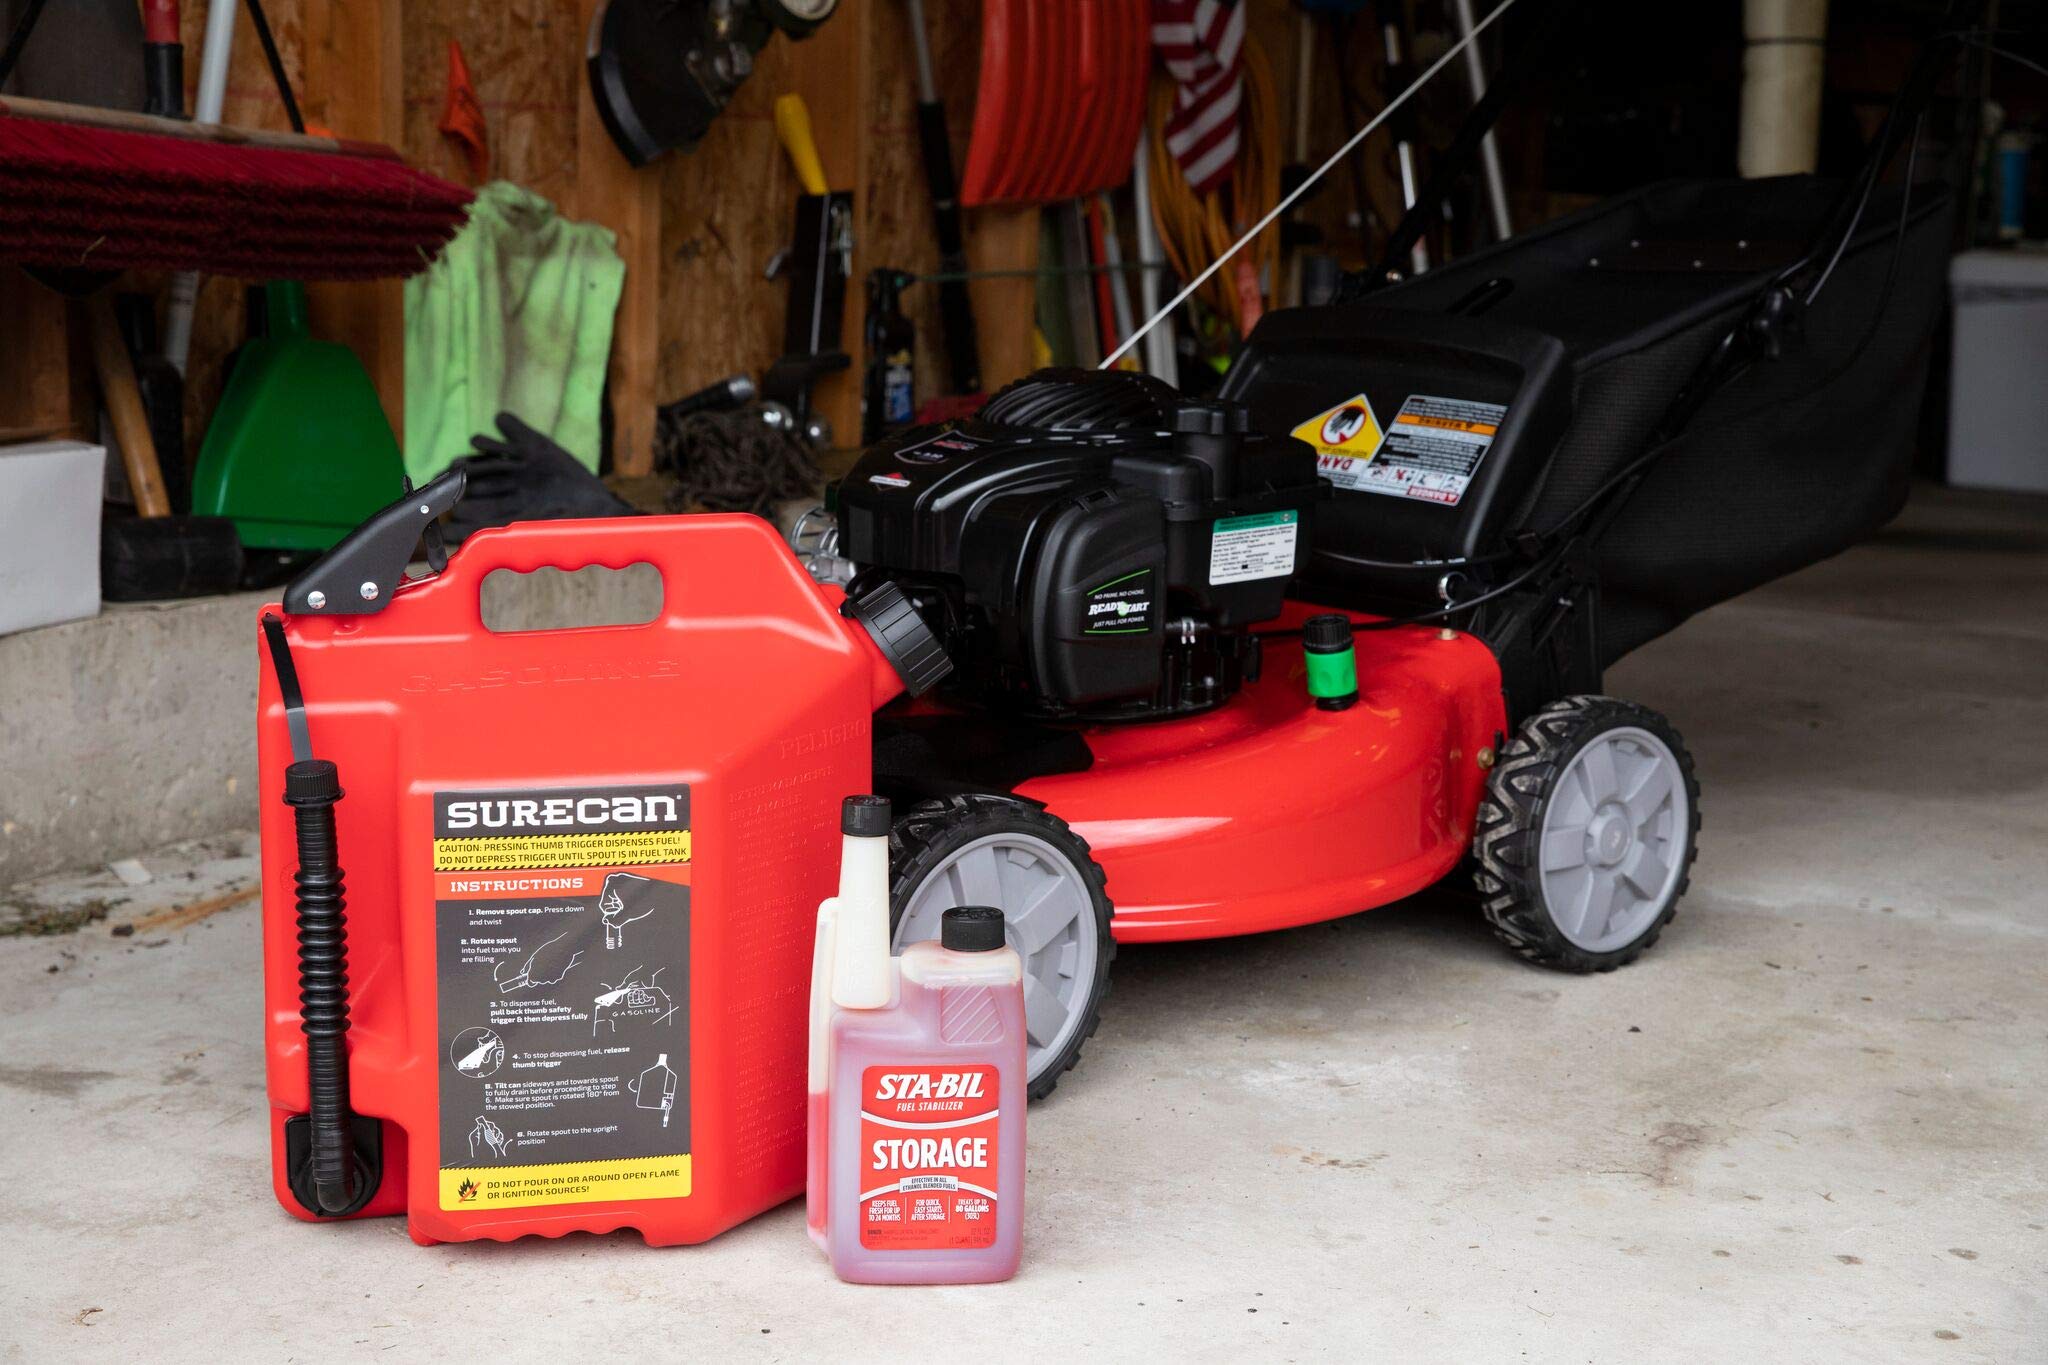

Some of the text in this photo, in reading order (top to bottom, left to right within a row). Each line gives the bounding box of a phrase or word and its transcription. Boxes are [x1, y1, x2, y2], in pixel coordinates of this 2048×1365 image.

[440, 837, 681, 853] CAUTION: PRESSING THUMB TRIGGER DISPENSES FUEL!
[440, 856, 452, 864] DO
[455, 856, 474, 864] NOT
[476, 855, 516, 863] DEPRESS
[518, 853, 557, 862] TRIGGER
[559, 852, 585, 861] UNTIL
[587, 851, 617, 860] SPOUT
[629, 850, 638, 858] IN
[640, 849, 661, 857] FUEL
[663, 848, 687, 856] TANK
[450, 878, 583, 892] INSTRUCTIONS
[475, 956, 495, 964] filling
[509, 1000, 540, 1008] dispense
[491, 1009, 505, 1017] pull
[612, 1008, 661, 1017] GASOLINE
[491, 1017, 515, 1025] trigger
[542, 1014, 570, 1022] depress
[550, 1050, 586, 1058] dispensing
[604, 1046, 630, 1054] release
[537, 1060, 562, 1068] trigger
[523, 1080, 555, 1088] sideways
[600, 1076, 619, 1084] spout
[876, 1072, 985, 1100] STA-BIL
[554, 1086, 591, 1094] proceeding
[602, 1083, 616, 1091] step
[560, 1092, 585, 1100] rotated
[897, 1101, 964, 1112] FUEL STABILIZER
[551, 1129, 571, 1137] spout
[593, 1125, 618, 1134] upright
[518, 1138, 546, 1147] position
[873, 1137, 988, 1170] STORAGE
[487, 1169, 680, 1189] DO NOT POUR ON OR AROUND OPEN FLAME
[487, 1186, 590, 1200] OR IGNITION SOURCES!
